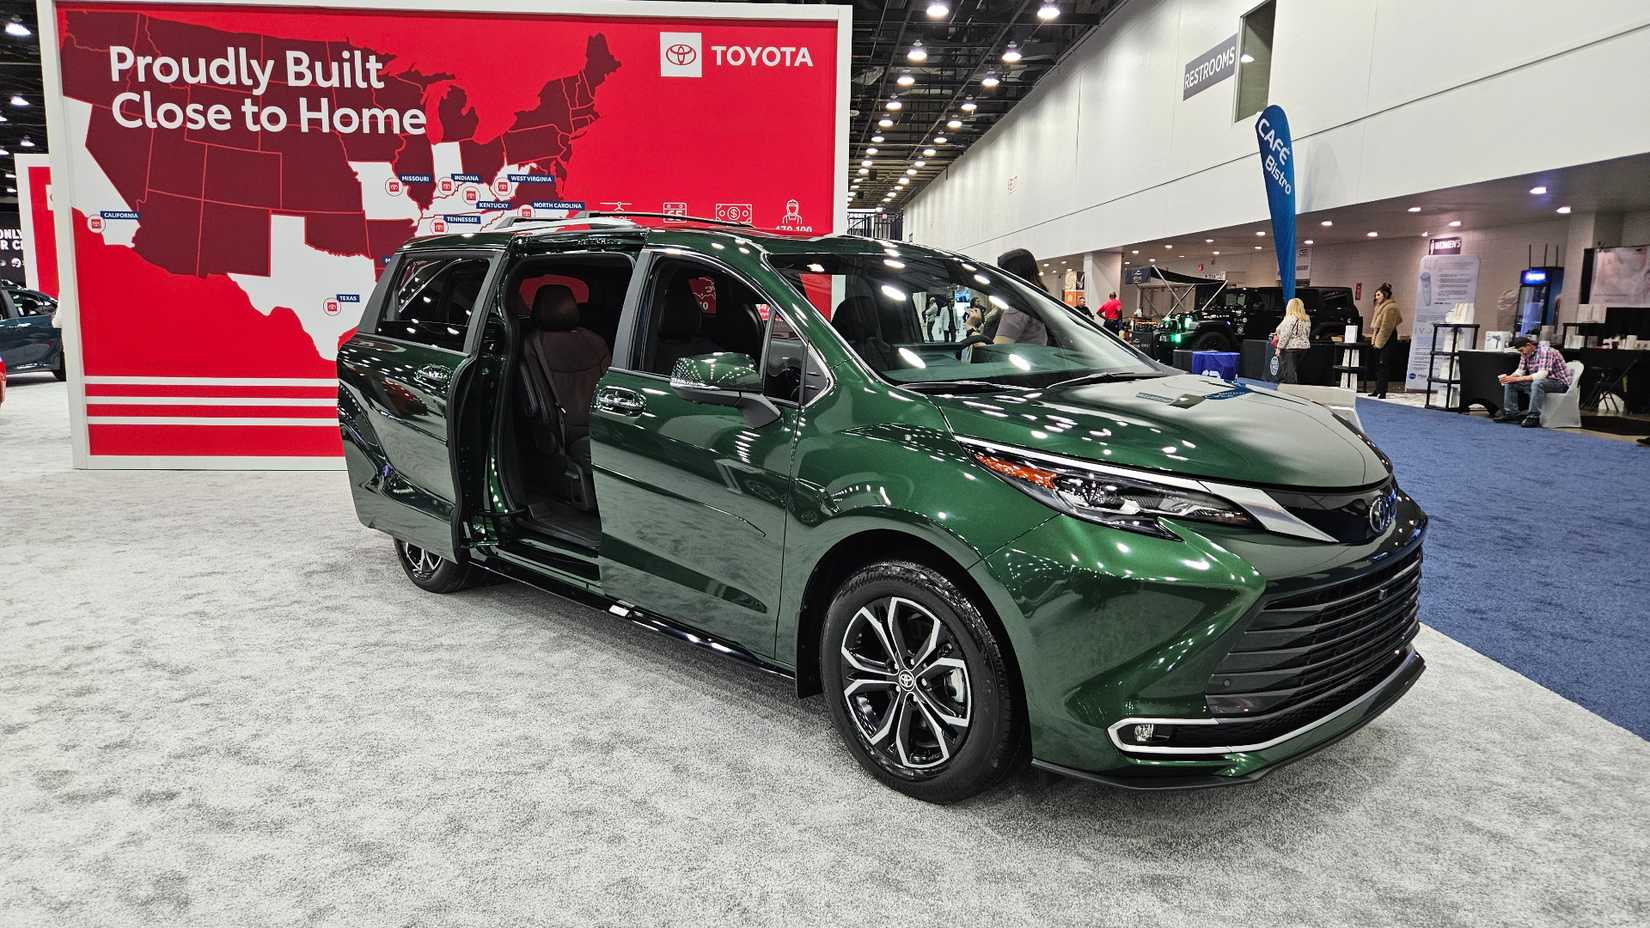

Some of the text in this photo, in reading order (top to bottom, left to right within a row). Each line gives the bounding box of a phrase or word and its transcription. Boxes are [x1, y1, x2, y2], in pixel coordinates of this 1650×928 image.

[109, 45, 385, 96] Proudly Built
[711, 45, 814, 67] TOYOTA
[1184, 46, 1235, 89] RESTROOMS
[112, 92, 427, 136] Close to Home
[454, 174, 479, 182] INDIANA
[1265, 154, 1292, 195] Bistro
[553, 202, 583, 210] CAROLINA
